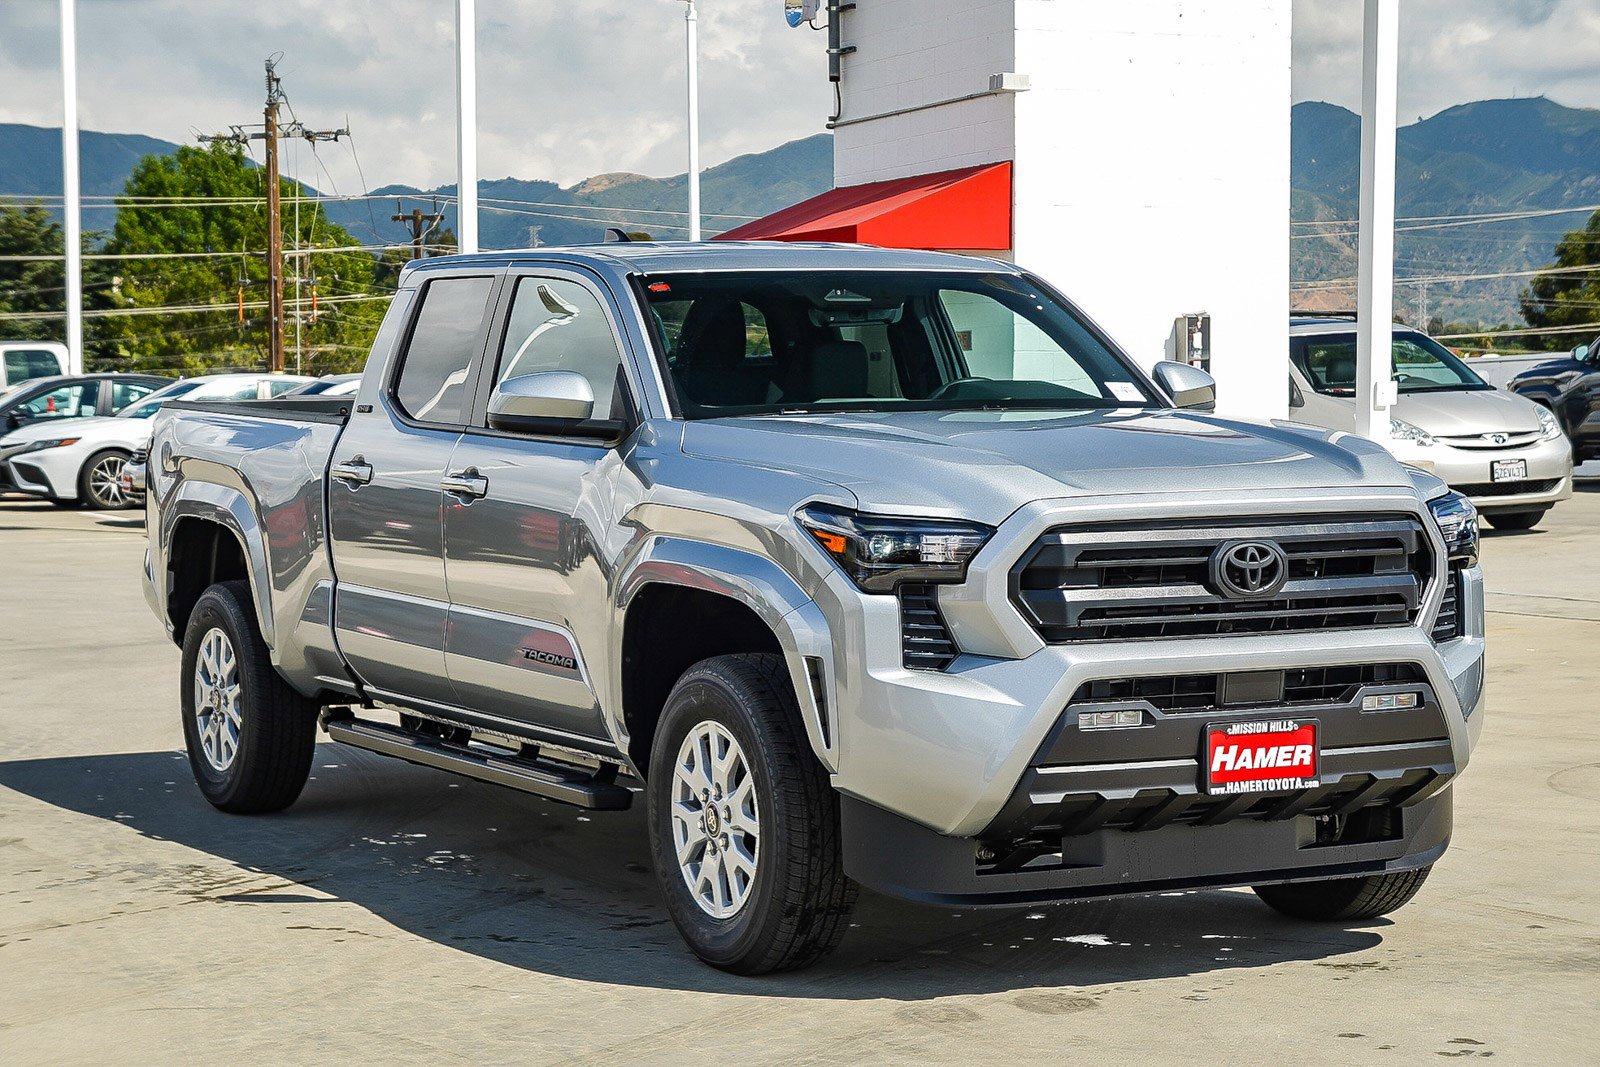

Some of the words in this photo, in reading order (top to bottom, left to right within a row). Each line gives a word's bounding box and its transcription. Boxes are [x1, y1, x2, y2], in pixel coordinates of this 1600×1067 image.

[517, 647, 574, 669] TACOMA
[1232, 722, 1266, 735] MISSION
[1270, 720, 1294, 732] HILLS
[1211, 745, 1313, 772] HAMER
[1210, 777, 1320, 796] www.HAMERTOYOTA.com
